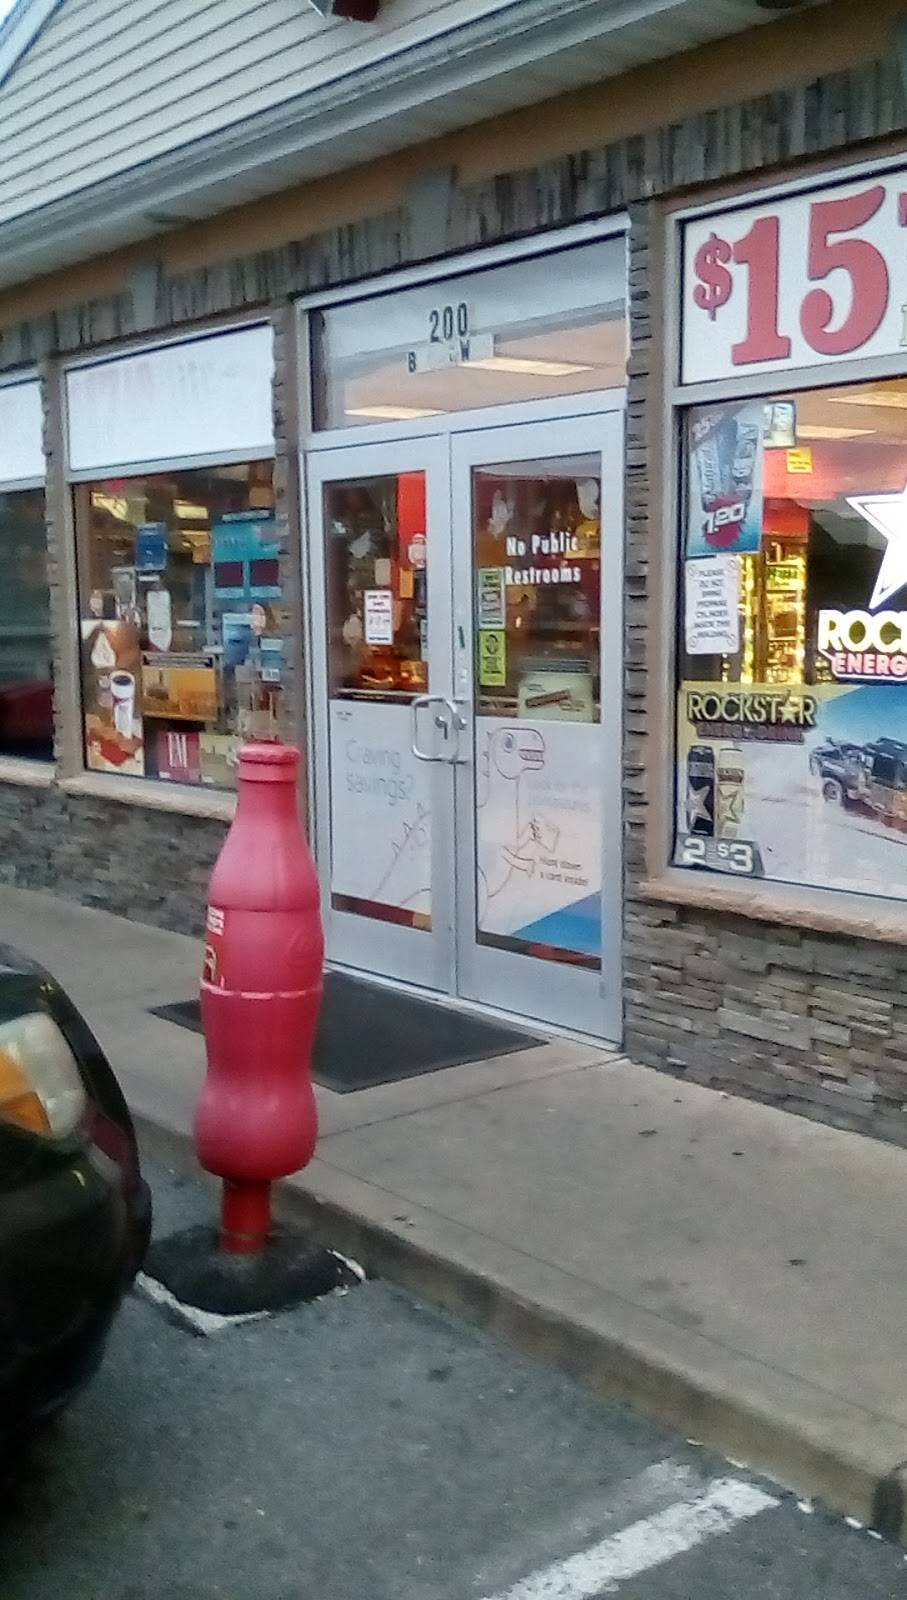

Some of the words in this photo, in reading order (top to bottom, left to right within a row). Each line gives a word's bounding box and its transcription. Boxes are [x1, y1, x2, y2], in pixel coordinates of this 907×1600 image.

[693, 185, 907, 367] $15
[429, 302, 468, 343] 200
[505, 535, 527, 556] No
[531, 530, 579, 555] Public
[504, 566, 582, 585] Restrooms
[818, 609, 907, 653] ROC
[682, 837, 706, 866] 2
